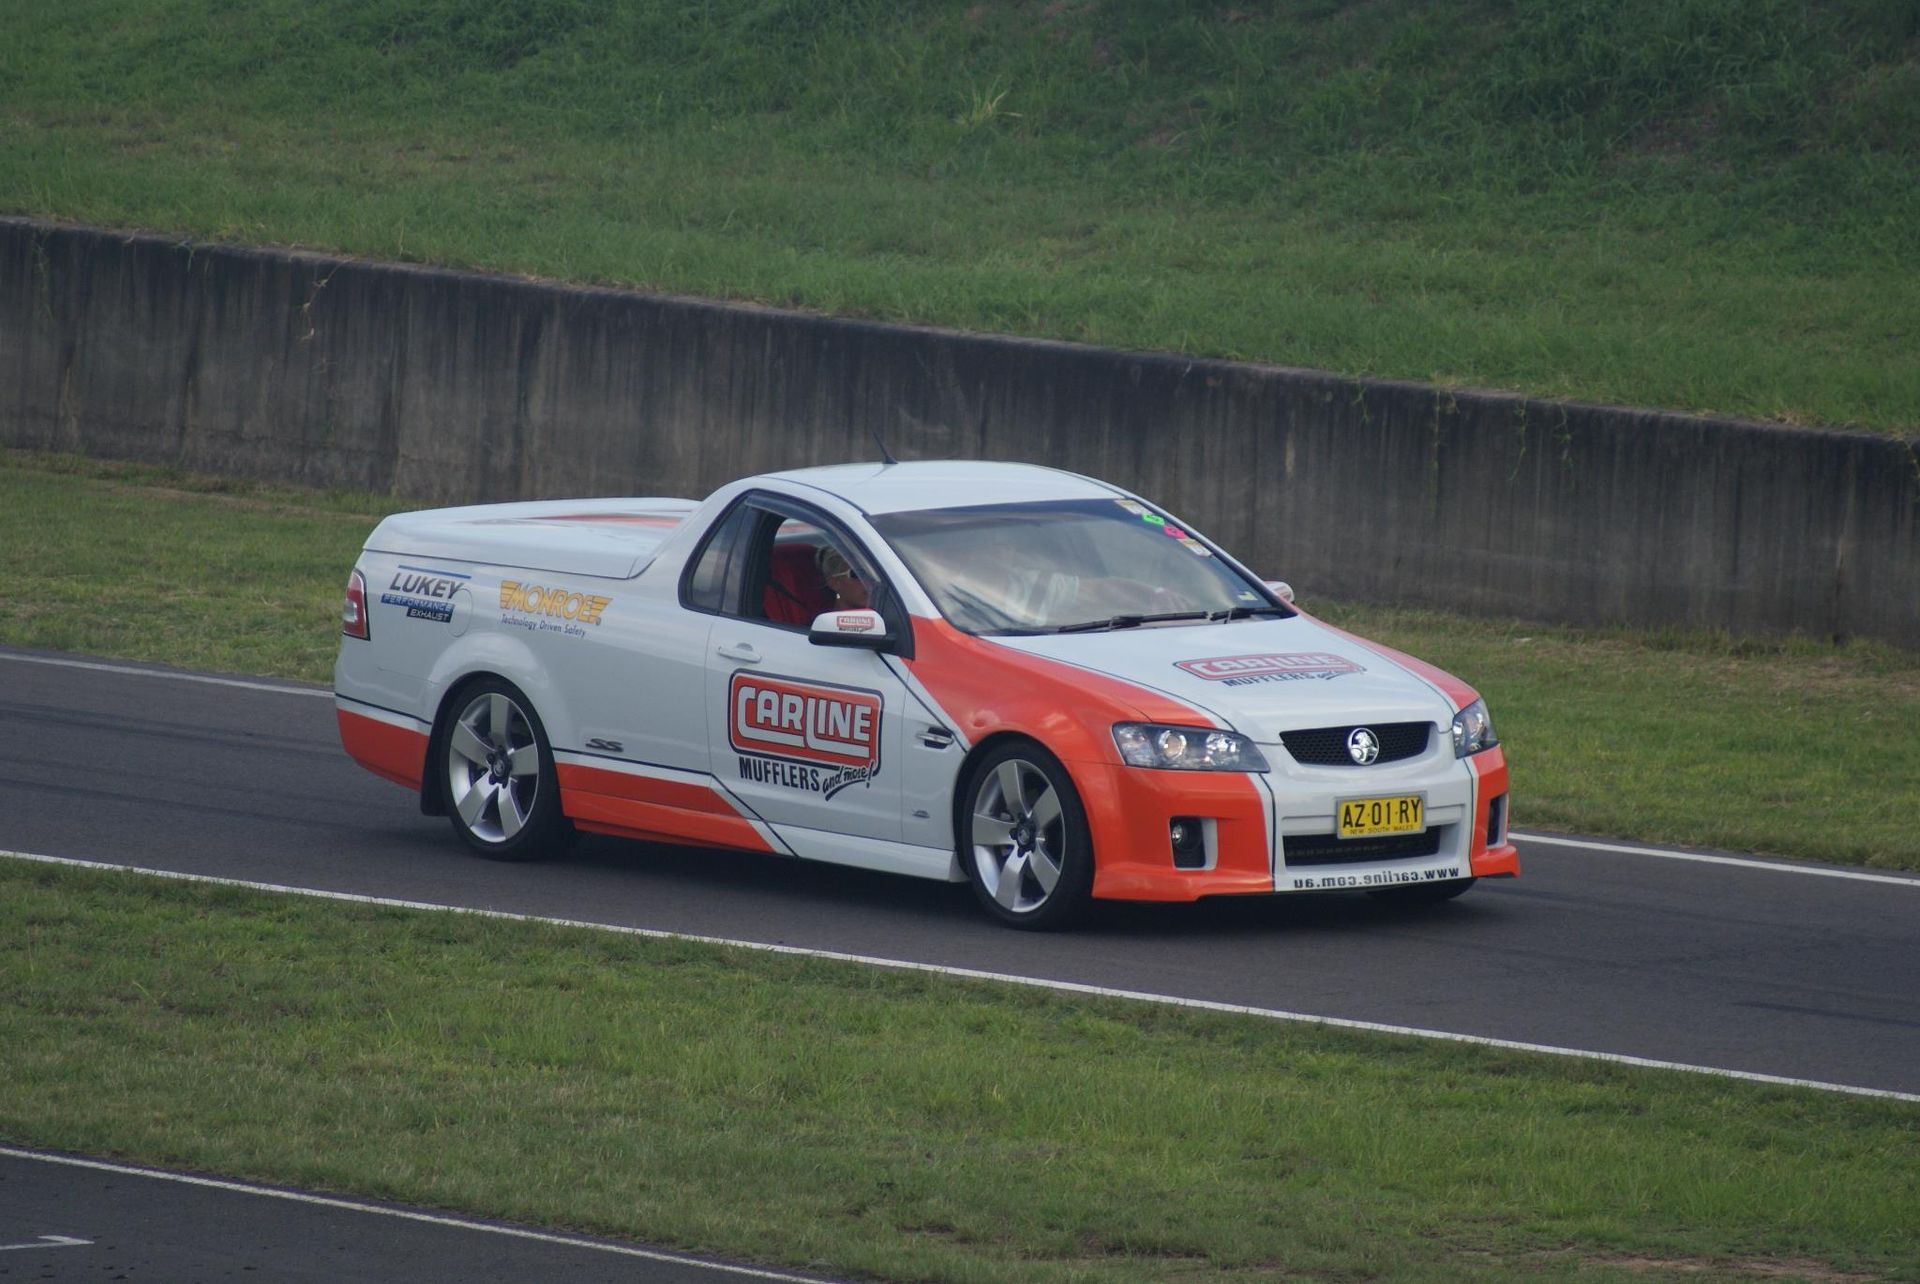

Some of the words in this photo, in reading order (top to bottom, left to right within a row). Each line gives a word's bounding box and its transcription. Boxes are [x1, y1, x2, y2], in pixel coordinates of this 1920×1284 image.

[389, 572, 465, 599] LUKEY
[383, 594, 453, 612] PERFORMANCE
[505, 582, 602, 624] MONROE
[410, 608, 449, 621] EXHAUST
[501, 614, 537, 630] Technology
[539, 619, 562, 633] Driven
[564, 623, 586, 638] Safety
[1190, 655, 1350, 677] CARLINE
[1222, 672, 1316, 687] MUFFLERS
[737, 686, 872, 759] CARLINE
[585, 738, 624, 753] SS
[739, 757, 820, 792] MUFFLERS
[822, 765, 844, 794] and
[1350, 828, 1365, 836] NEW
[1368, 826, 1391, 834] SOUTH
[1393, 824, 1414, 832] WALES
